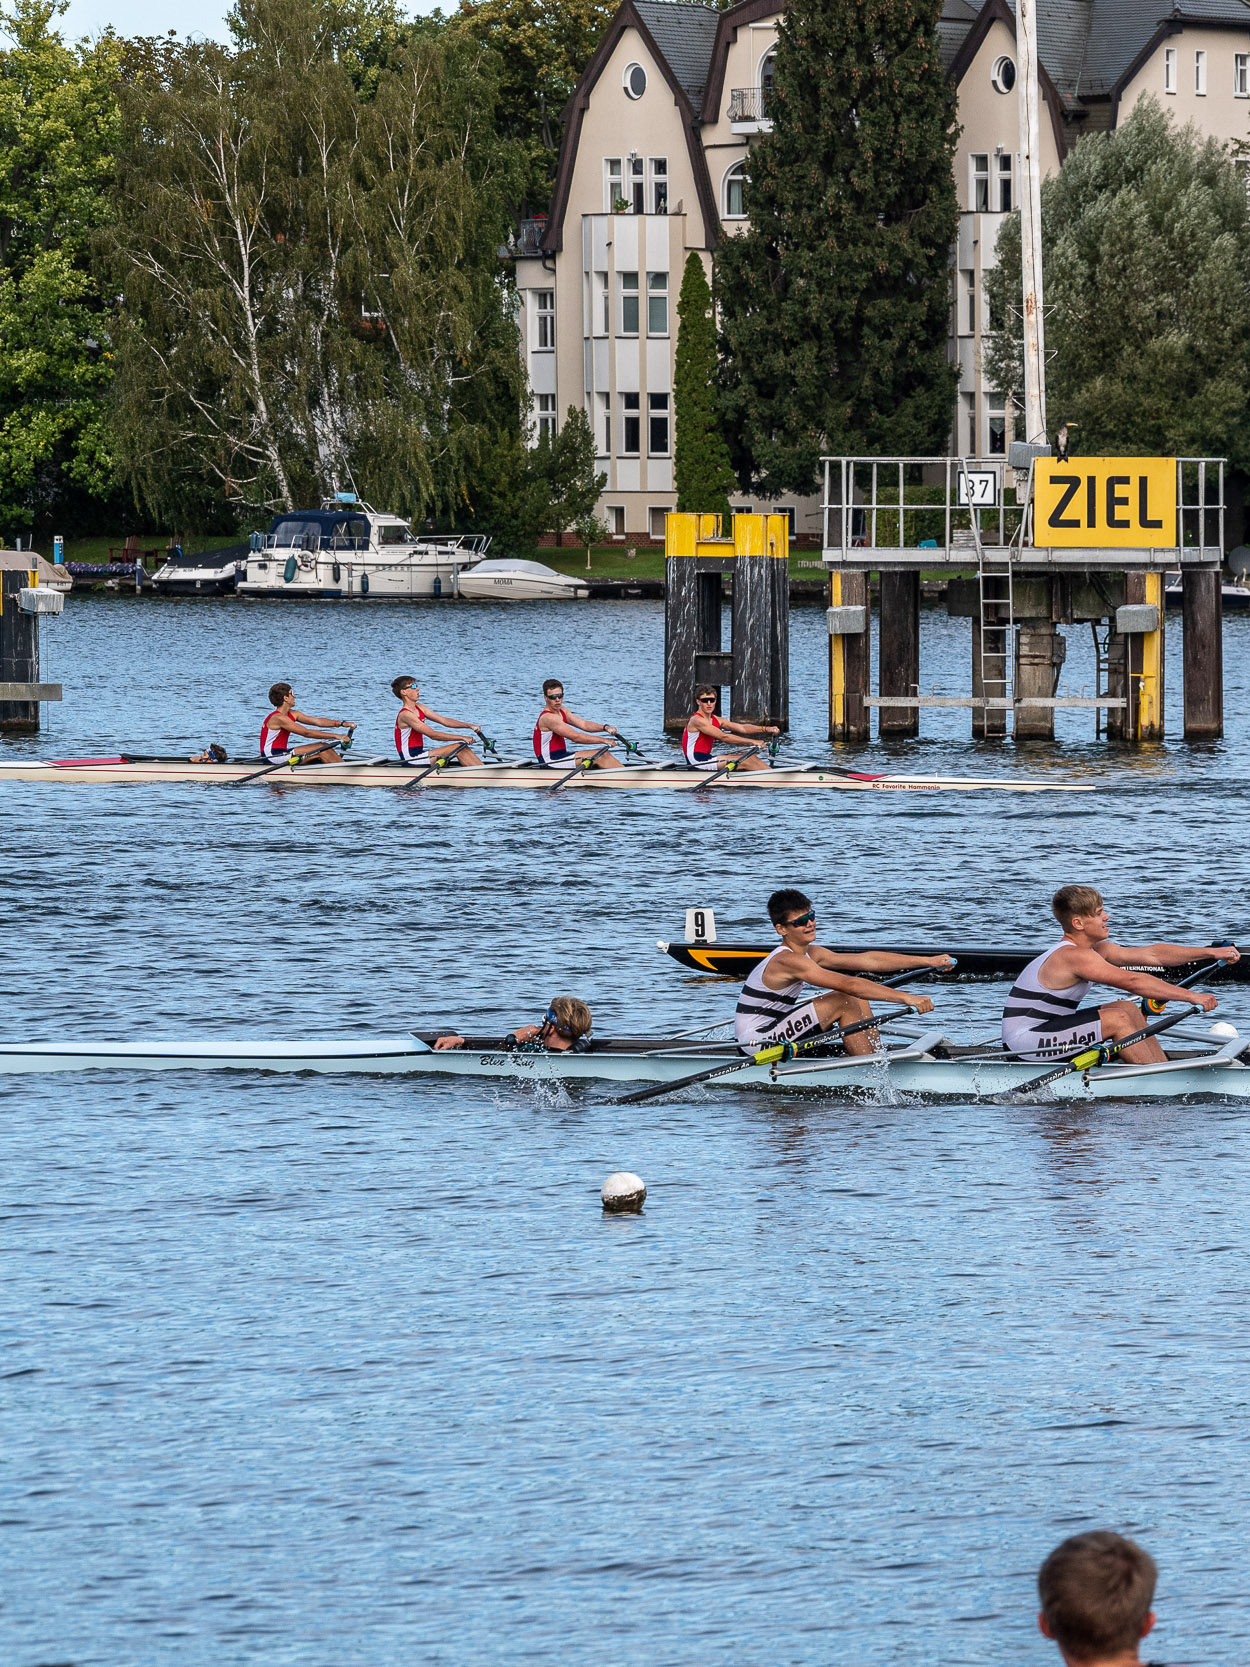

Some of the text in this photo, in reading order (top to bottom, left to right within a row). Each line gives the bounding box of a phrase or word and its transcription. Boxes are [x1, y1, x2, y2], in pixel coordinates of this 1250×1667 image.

[965, 479, 989, 498] 37
[1047, 475, 1163, 529] ZIEL
[694, 911, 706, 938] 9
[1036, 1031, 1096, 1058] Minden
[480, 1055, 506, 1067] Blue
